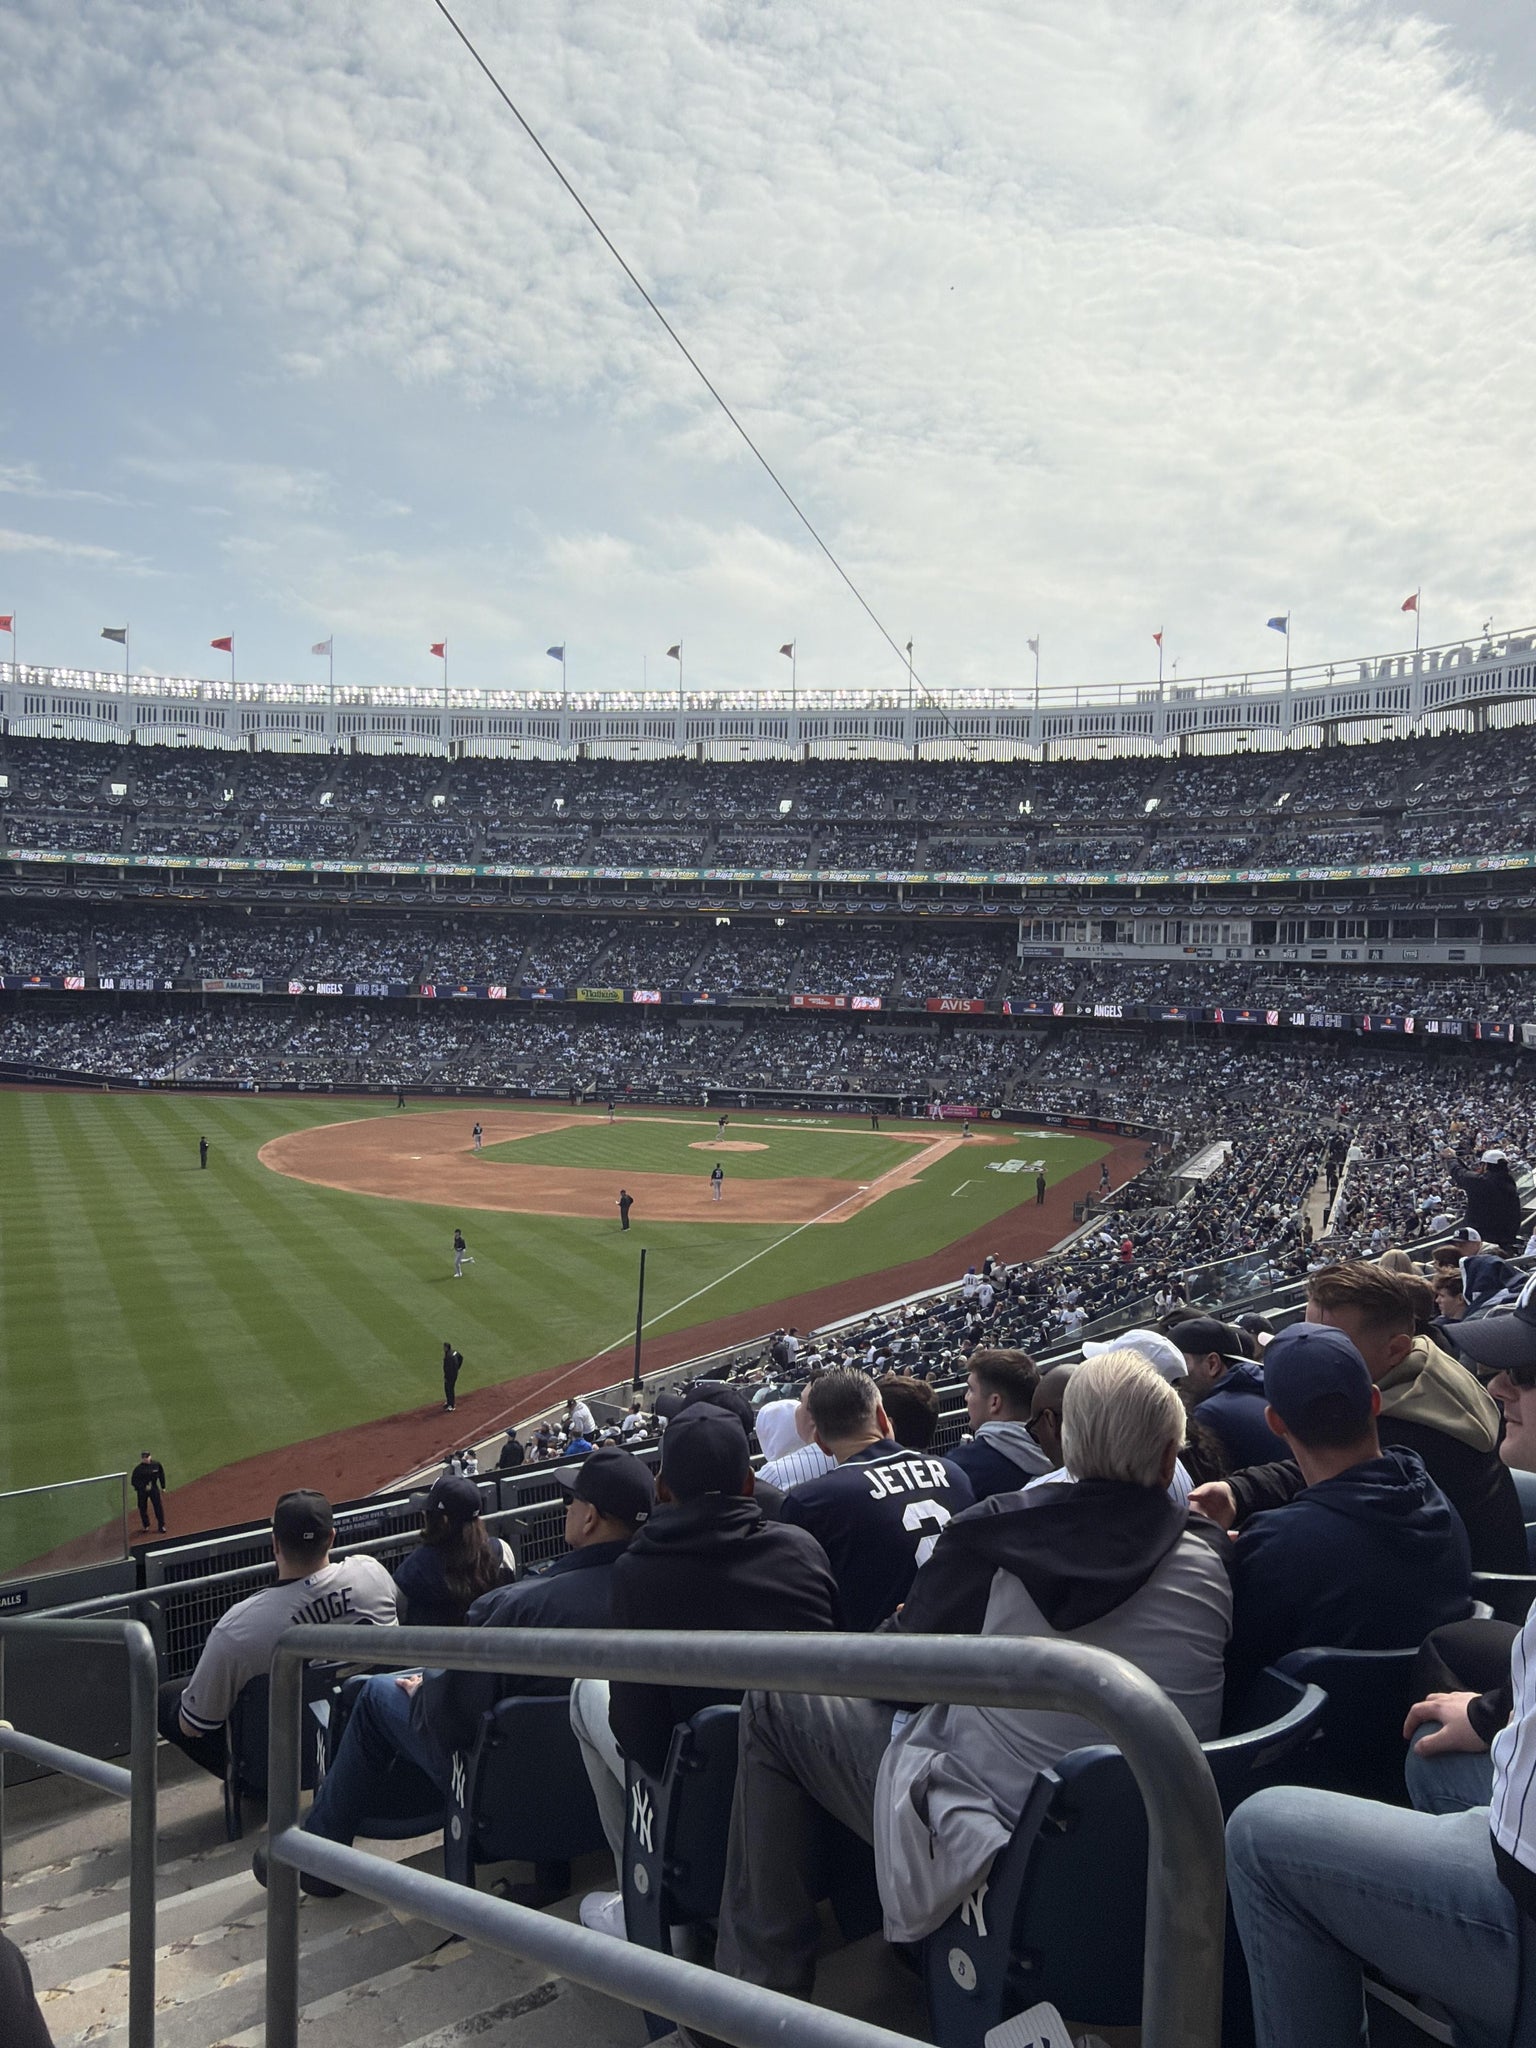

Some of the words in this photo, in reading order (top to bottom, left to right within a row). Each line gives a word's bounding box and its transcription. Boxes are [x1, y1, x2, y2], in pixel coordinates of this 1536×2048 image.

[312, 824, 344, 832] VODKA
[100, 979, 114, 990] LAA
[316, 984, 343, 995] ANGELS
[940, 1000, 971, 1011] AVIS
[1094, 1005, 1123, 1018] ANGELS
[1292, 1013, 1305, 1026] LAA
[864, 1460, 950, 1500] JETER
[902, 1499, 952, 1568] 2
[0, 1594, 22, 1606] ALLS
[452, 1750, 465, 1808] NY
[631, 1780, 654, 1854] NY
